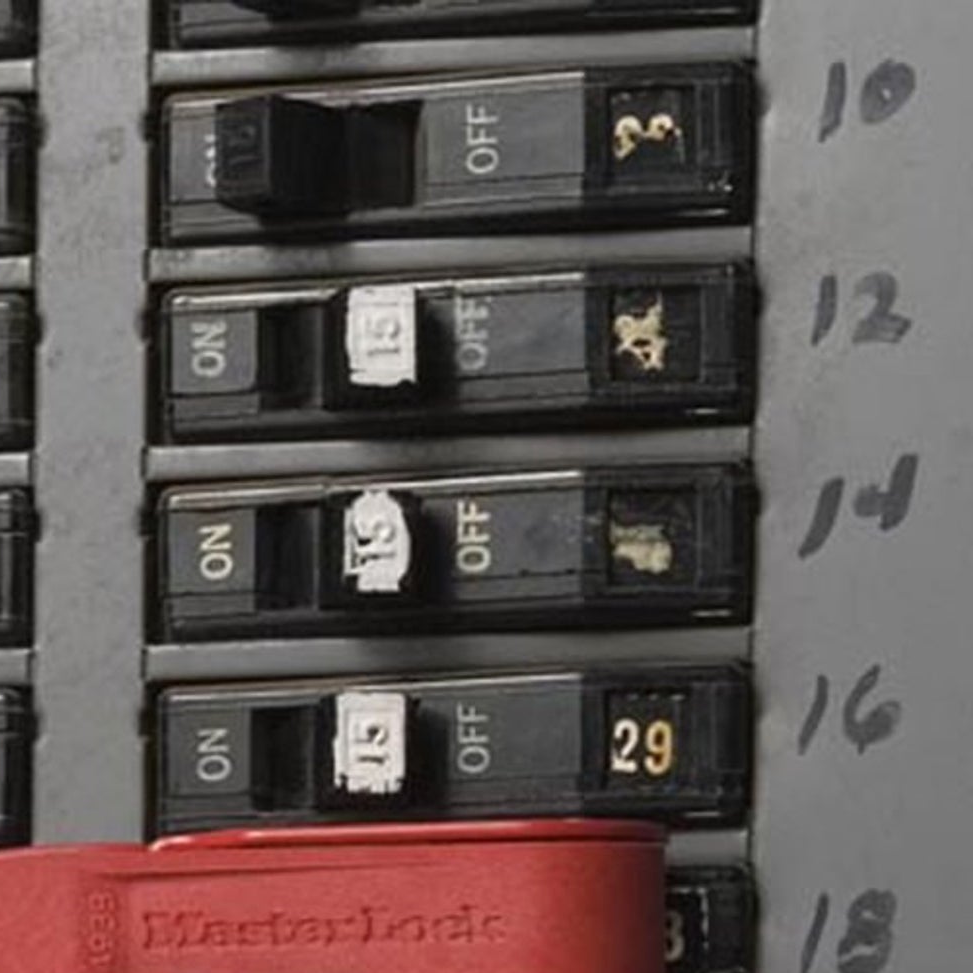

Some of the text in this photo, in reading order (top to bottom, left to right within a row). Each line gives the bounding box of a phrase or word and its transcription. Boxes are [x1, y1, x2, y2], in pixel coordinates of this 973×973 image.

[819, 59, 915, 142] 10
[466, 104, 498, 175] OFF
[455, 297, 492, 371] OFF
[811, 272, 912, 346] 12
[192, 320, 226, 378] ON
[457, 500, 492, 573] OFF
[798, 454, 918, 559] 14
[199, 523, 234, 580] ON
[354, 723, 394, 765] 15
[457, 703, 491, 774] OFF
[799, 665, 900, 755] 16
[197, 728, 231, 782] ON
[612, 718, 674, 775] 29
